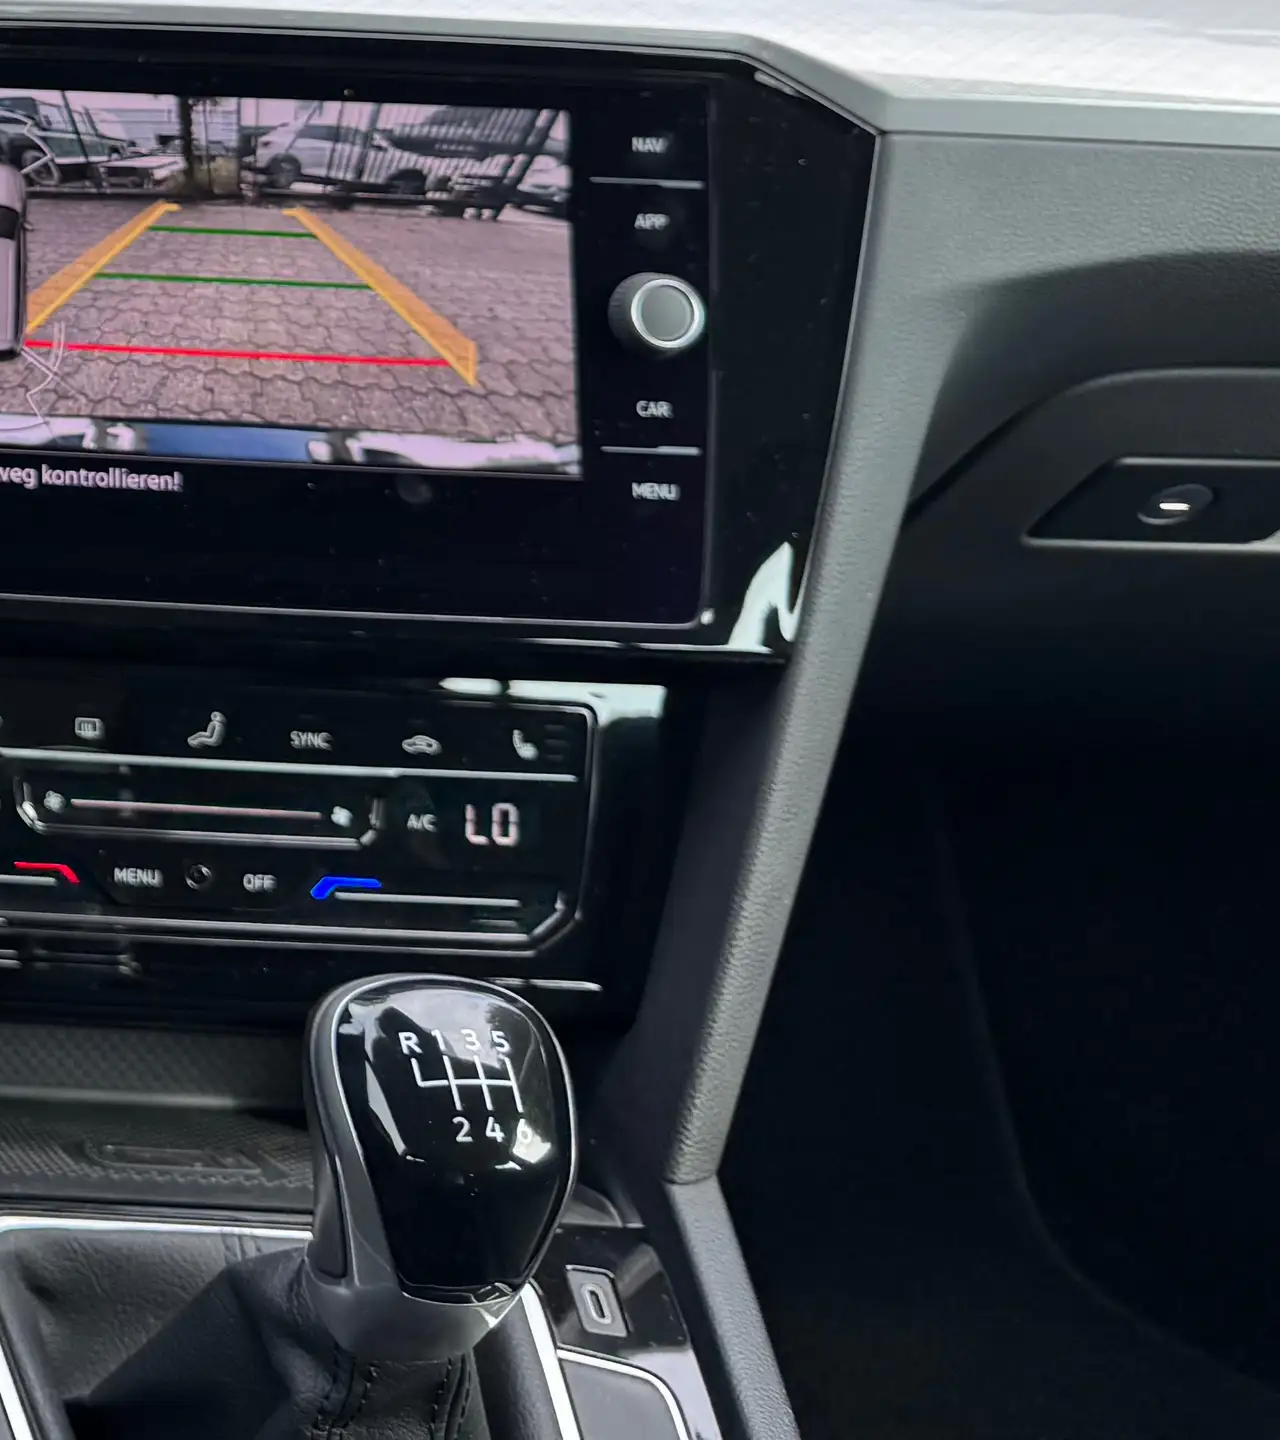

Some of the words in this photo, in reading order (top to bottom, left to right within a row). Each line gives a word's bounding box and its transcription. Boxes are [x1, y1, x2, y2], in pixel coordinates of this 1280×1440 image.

[631, 136, 668, 154] NAV
[634, 213, 670, 230] APP
[635, 400, 674, 418] CAR
[41, 462, 184, 492] kontrollieren!
[631, 482, 680, 502] MENU
[290, 730, 334, 751] SYNC
[406, 813, 438, 833] A/C
[464, 801, 521, 847] LO
[114, 866, 163, 888] MENU
[243, 873, 278, 893] OFF
[398, 1031, 424, 1056] R
[430, 1028, 447, 1052] 1
[460, 1028, 482, 1052] 3
[491, 1030, 512, 1054] 5
[452, 1116, 475, 1144] 2
[485, 1116, 506, 1144] 4
[516, 1117, 533, 1145] 6
